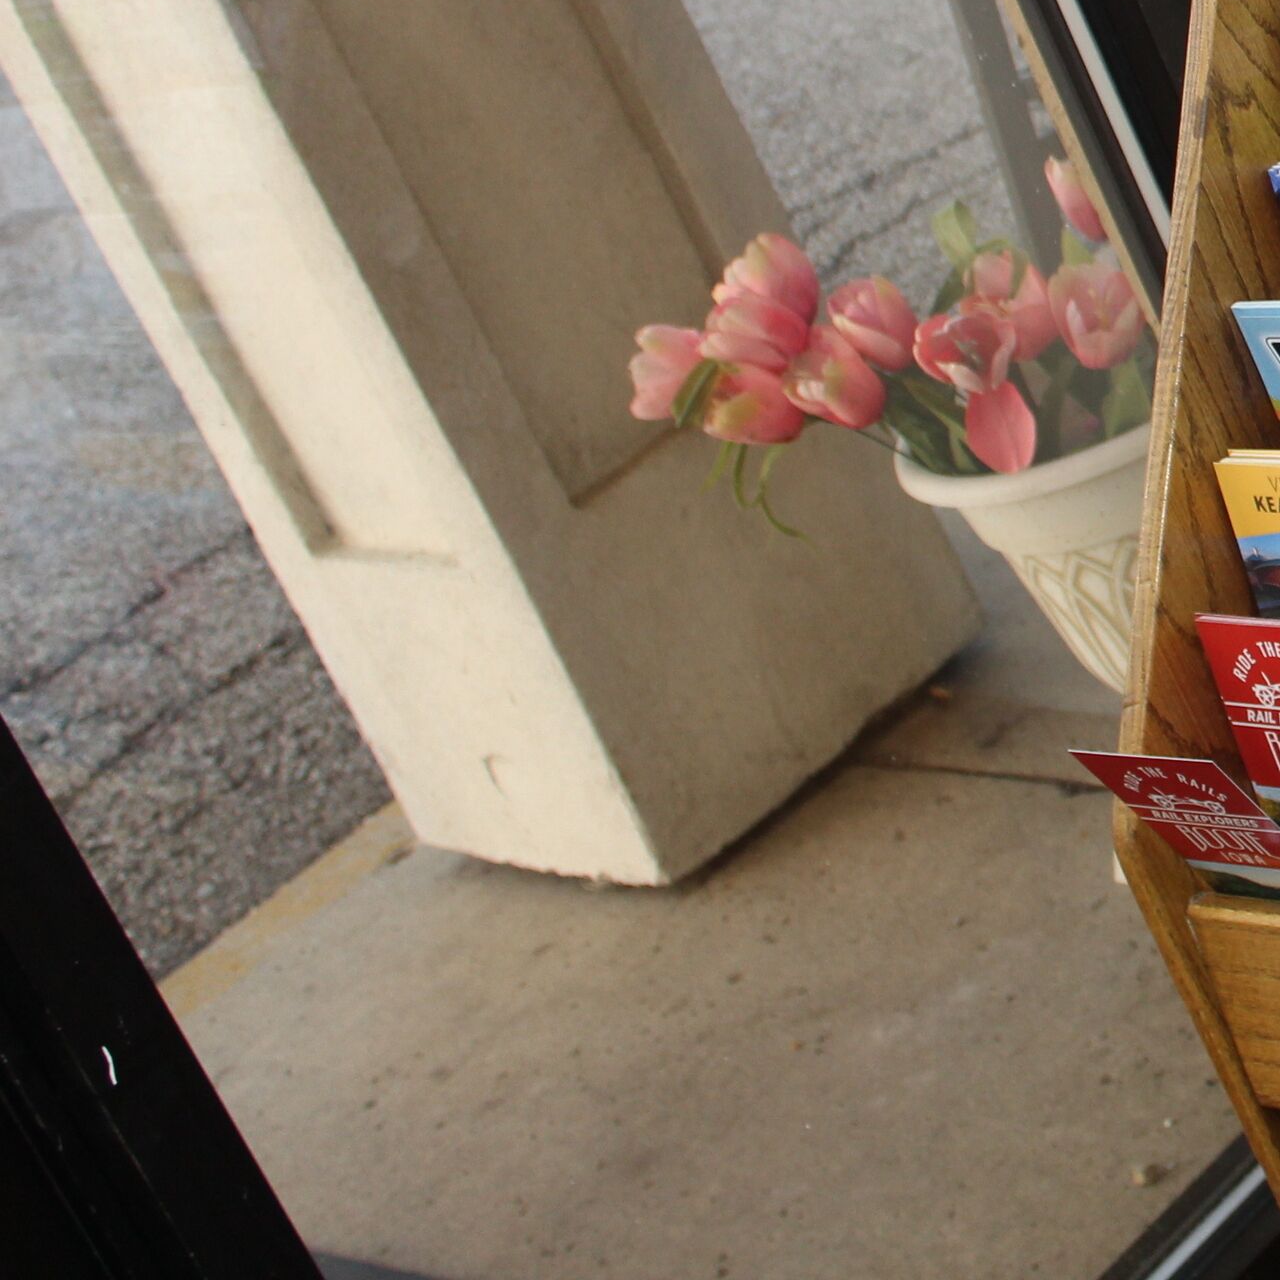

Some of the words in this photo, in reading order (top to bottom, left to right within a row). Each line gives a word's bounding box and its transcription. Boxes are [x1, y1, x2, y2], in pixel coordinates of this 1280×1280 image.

[1247, 709, 1276, 724] RAIL
[1124, 770, 1142, 793] RIDE
[1139, 766, 1168, 779] THE
[1176, 773, 1228, 803] RAILS
